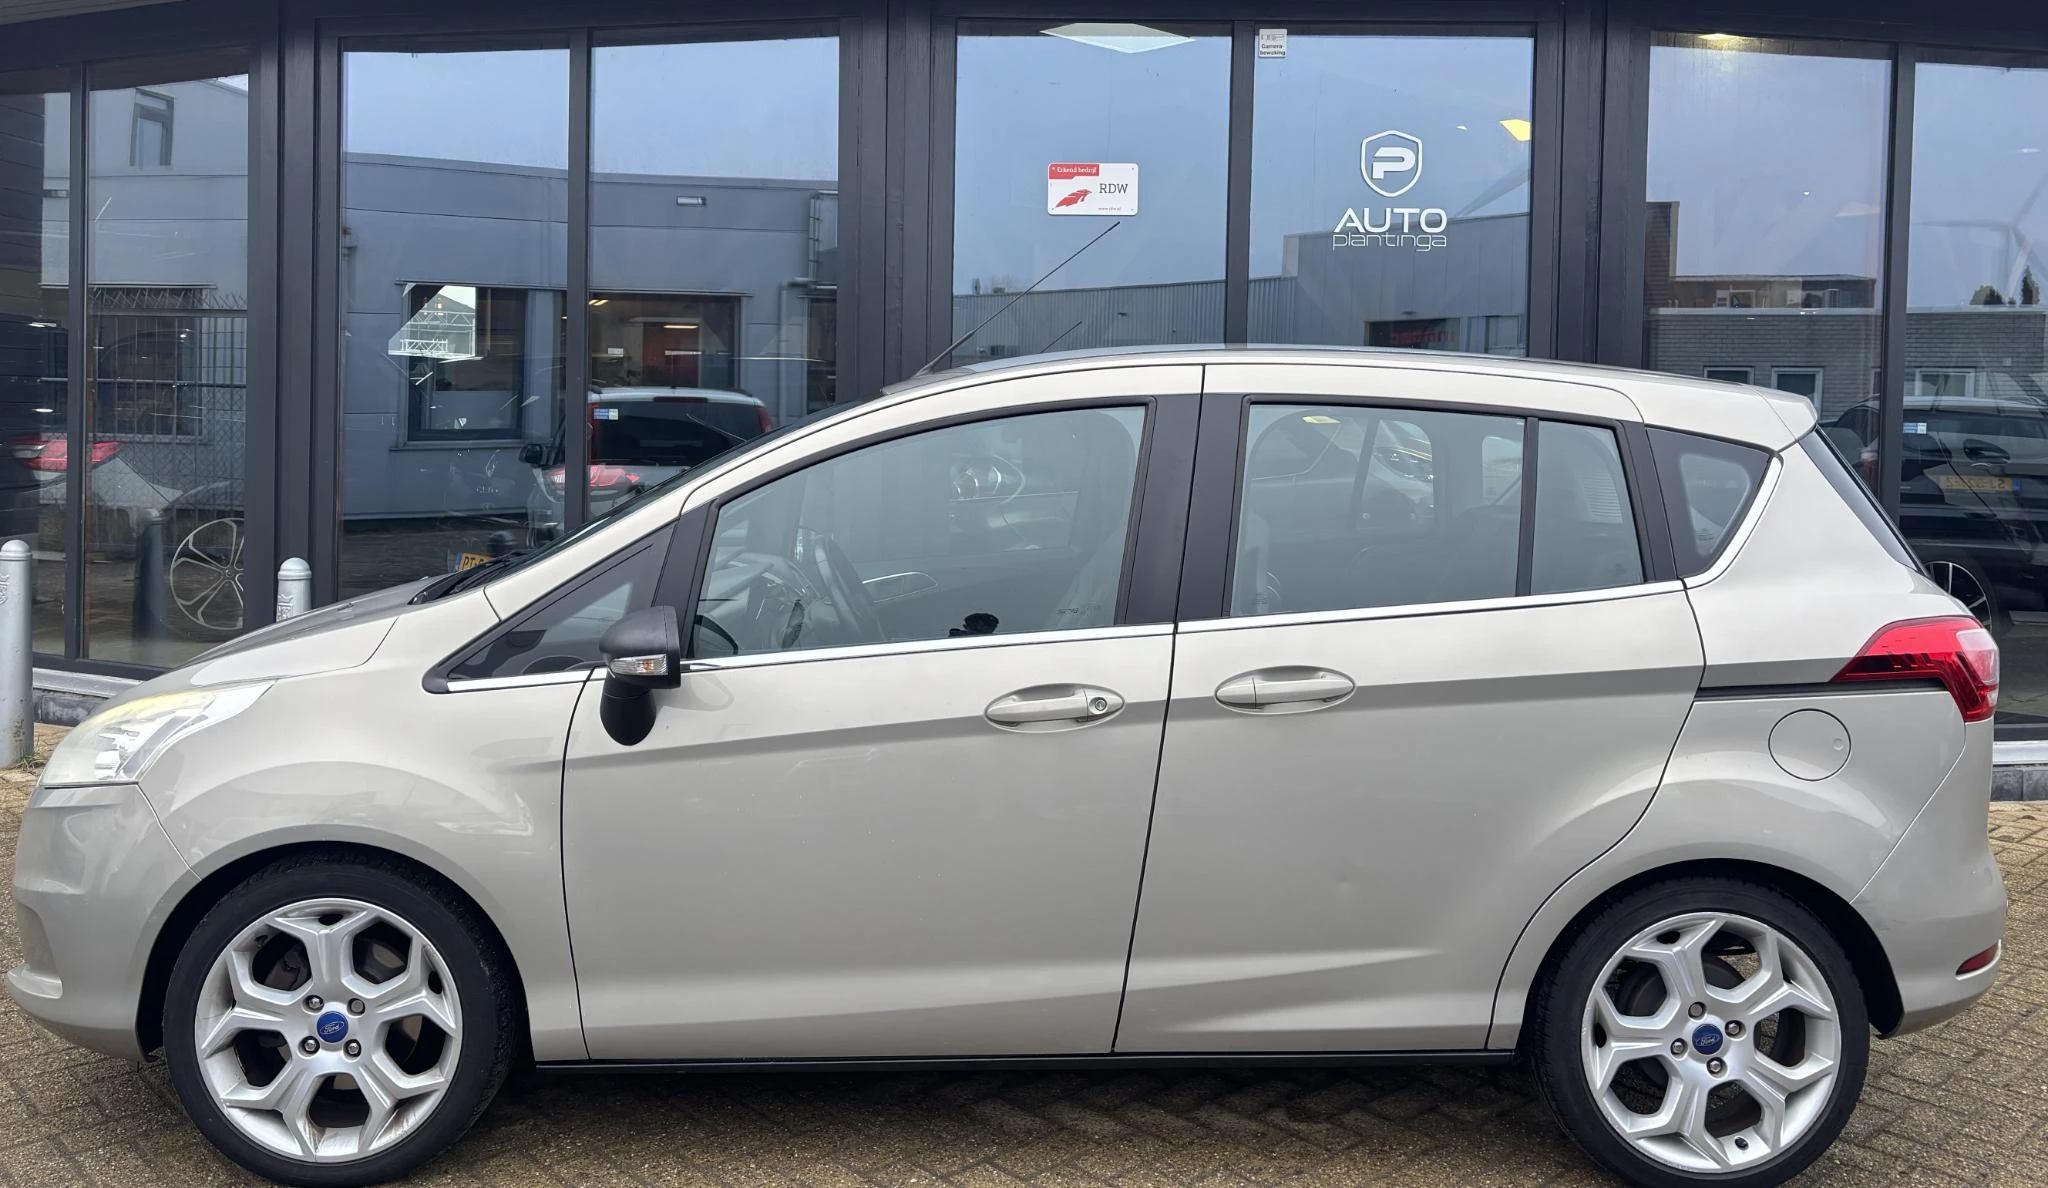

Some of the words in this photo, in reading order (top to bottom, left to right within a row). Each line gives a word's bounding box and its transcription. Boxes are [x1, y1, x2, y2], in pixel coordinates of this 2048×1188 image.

[1372, 146, 1416, 179] P
[1099, 183, 1128, 194] RDW
[1333, 207, 1447, 233] AUTO
[1332, 232, 1447, 252] plantinga
